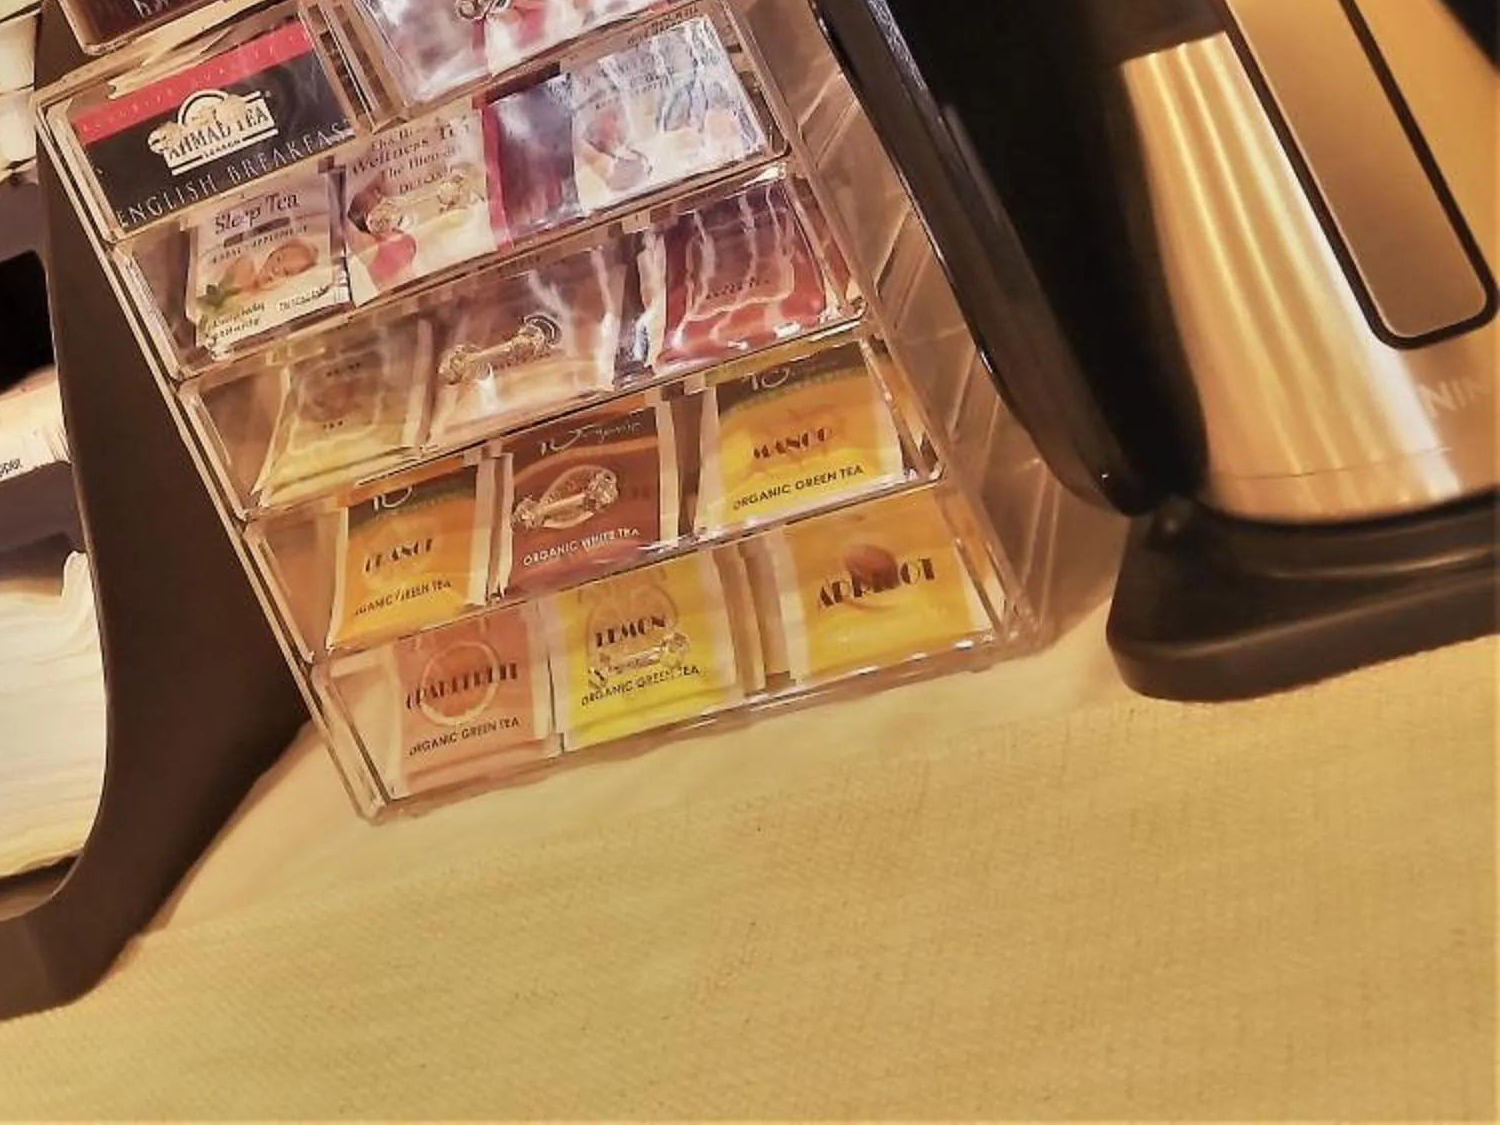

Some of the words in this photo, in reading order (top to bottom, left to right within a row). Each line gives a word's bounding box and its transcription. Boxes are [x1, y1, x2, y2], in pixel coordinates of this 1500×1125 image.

[168, 122, 232, 160] AHMAD
[116, 175, 218, 226] ENGLISH
[214, 205, 262, 235] Sleep
[265, 193, 301, 213] Tea
[733, 483, 791, 511] ORGANIC
[795, 471, 837, 491] GREEN
[840, 464, 865, 480] TEA
[523, 540, 578, 566] ORGANIC
[581, 529, 616, 551] WHITE
[618, 526, 642, 539] TEA
[432, 578, 452, 592] TEA
[581, 679, 633, 706] ORGANIC
[409, 732, 457, 756] ORGANIC
[461, 720, 498, 739] GREEN
[499, 716, 520, 730] TEA
